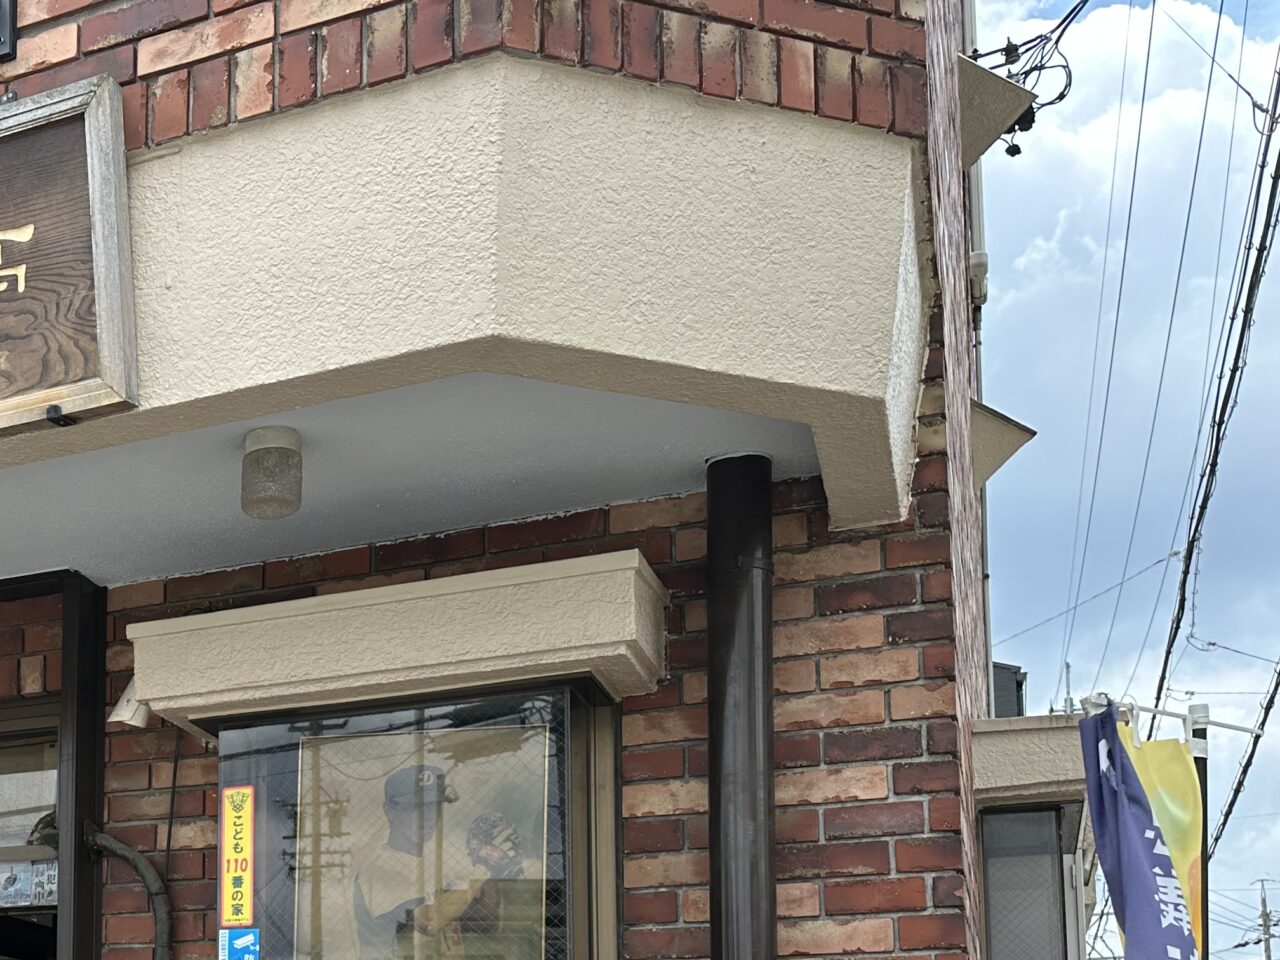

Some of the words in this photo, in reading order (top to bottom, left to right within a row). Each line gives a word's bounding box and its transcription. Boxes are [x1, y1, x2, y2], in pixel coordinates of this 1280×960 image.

[224, 815, 249, 917] こども110番の家
